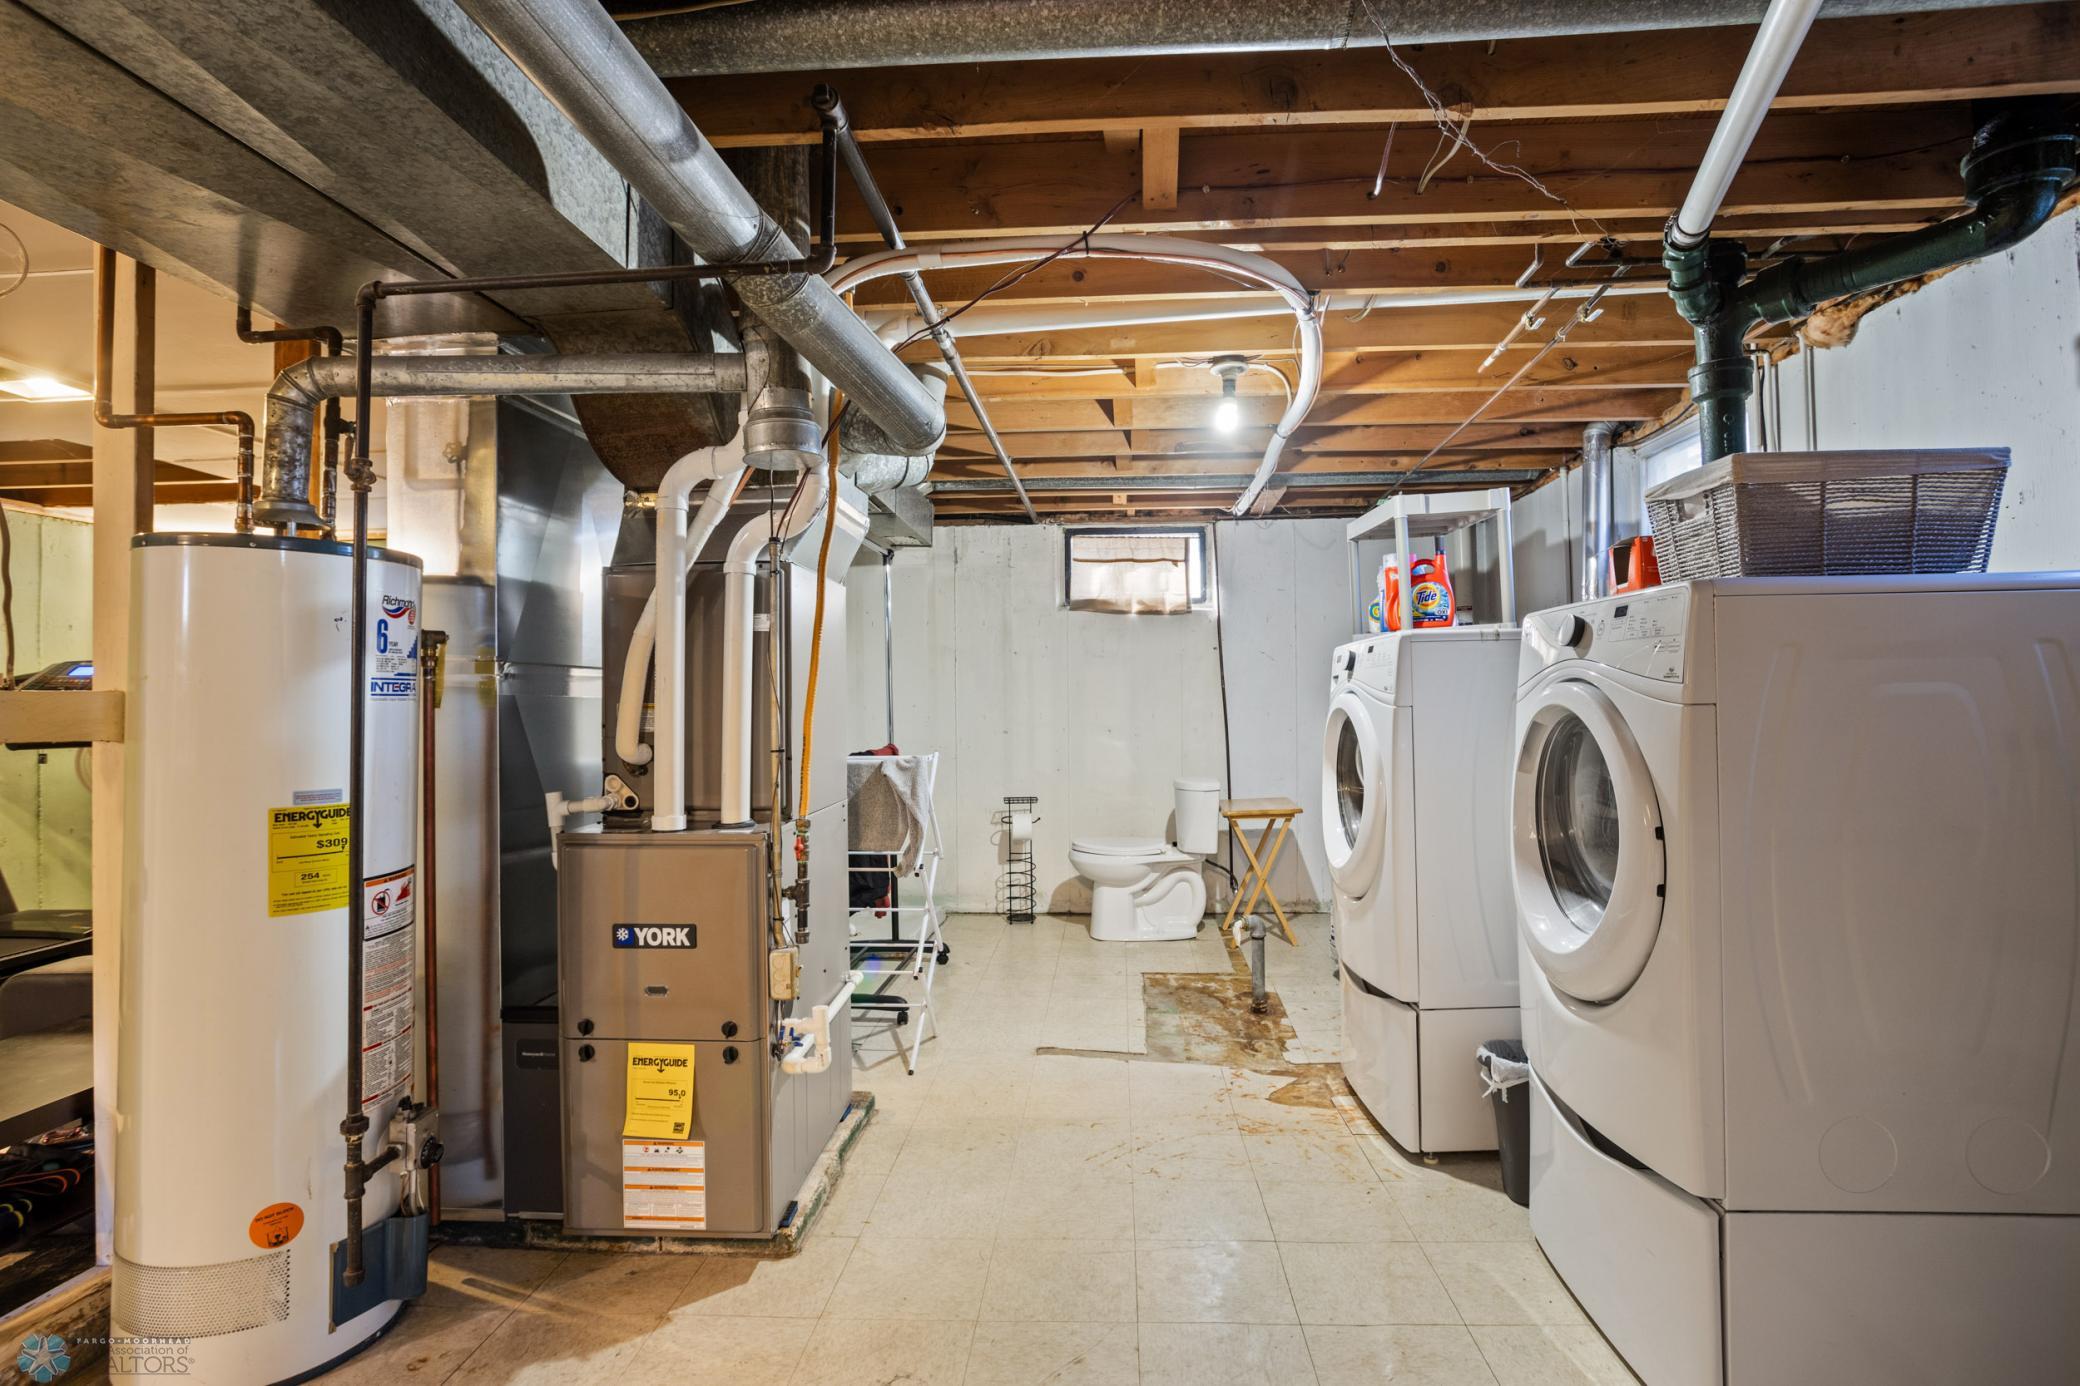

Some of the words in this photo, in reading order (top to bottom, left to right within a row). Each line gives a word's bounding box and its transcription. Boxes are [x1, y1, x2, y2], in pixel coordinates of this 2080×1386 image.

[1416, 590, 1438, 605] Tide
[376, 618, 389, 654] 6
[316, 837, 348, 849] $309
[300, 872, 320, 880] 254
[633, 927, 691, 946] YORK
